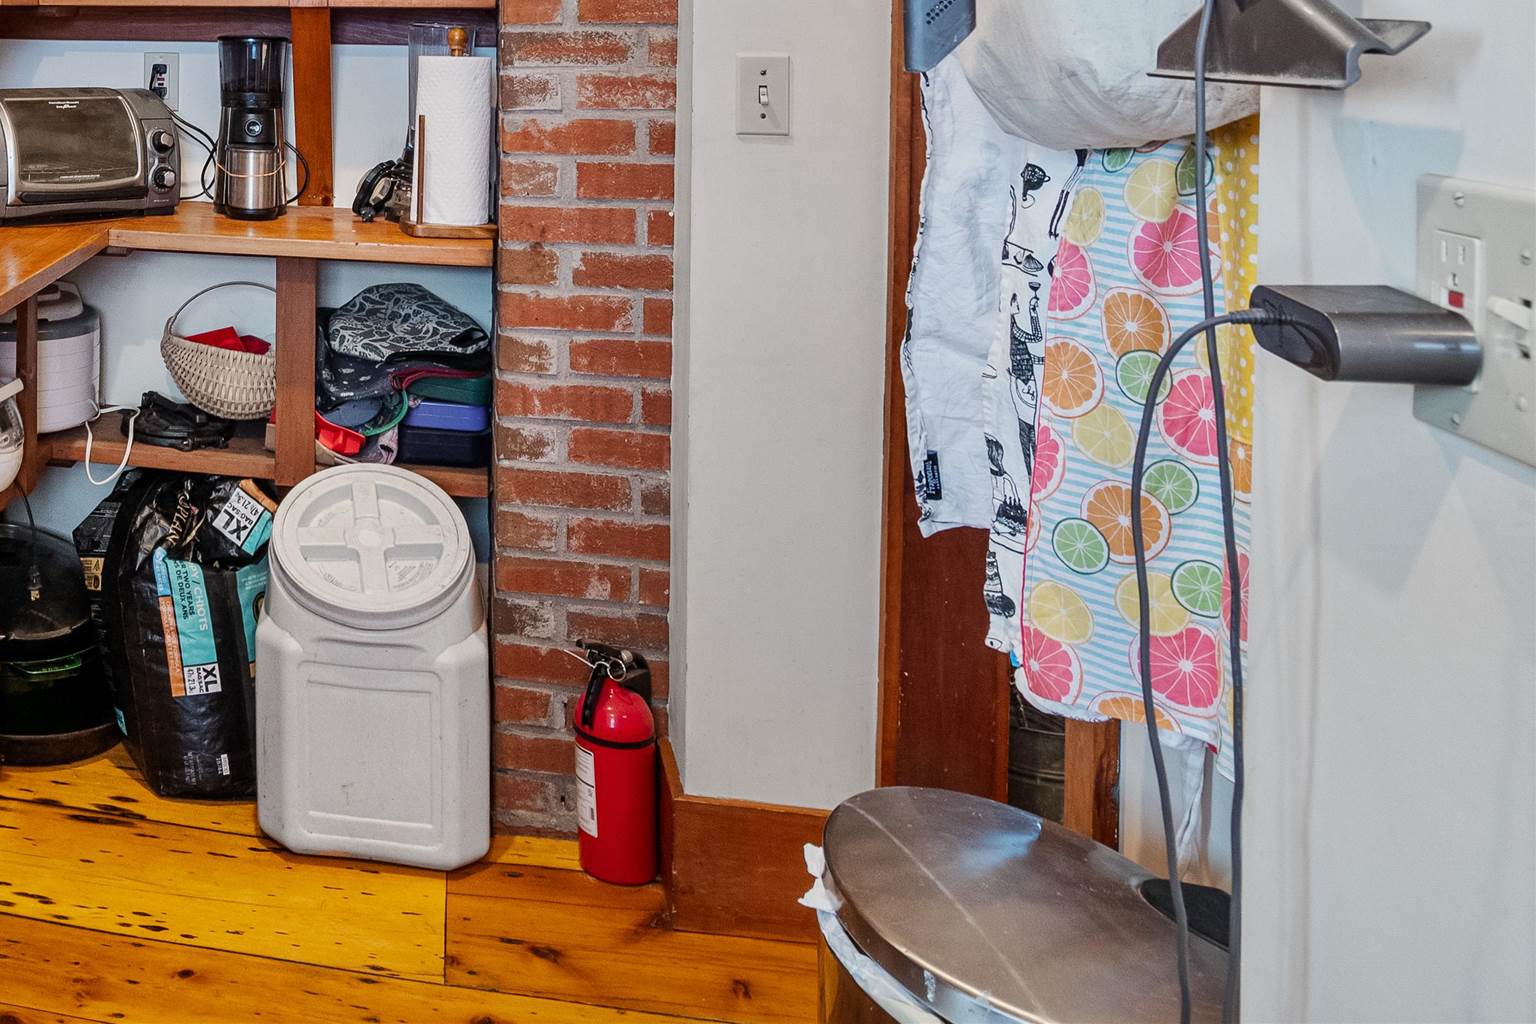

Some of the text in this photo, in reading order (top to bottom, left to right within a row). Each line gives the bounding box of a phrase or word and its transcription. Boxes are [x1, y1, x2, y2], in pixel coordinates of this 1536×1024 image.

[166, 504, 191, 546] PLAN
[222, 508, 248, 542] XL
[177, 579, 186, 601] DEUX
[186, 585, 196, 616] YEARS
[181, 602, 189, 620] ANS
[194, 586, 208, 631] CHIOTS
[202, 667, 216, 693] XL
